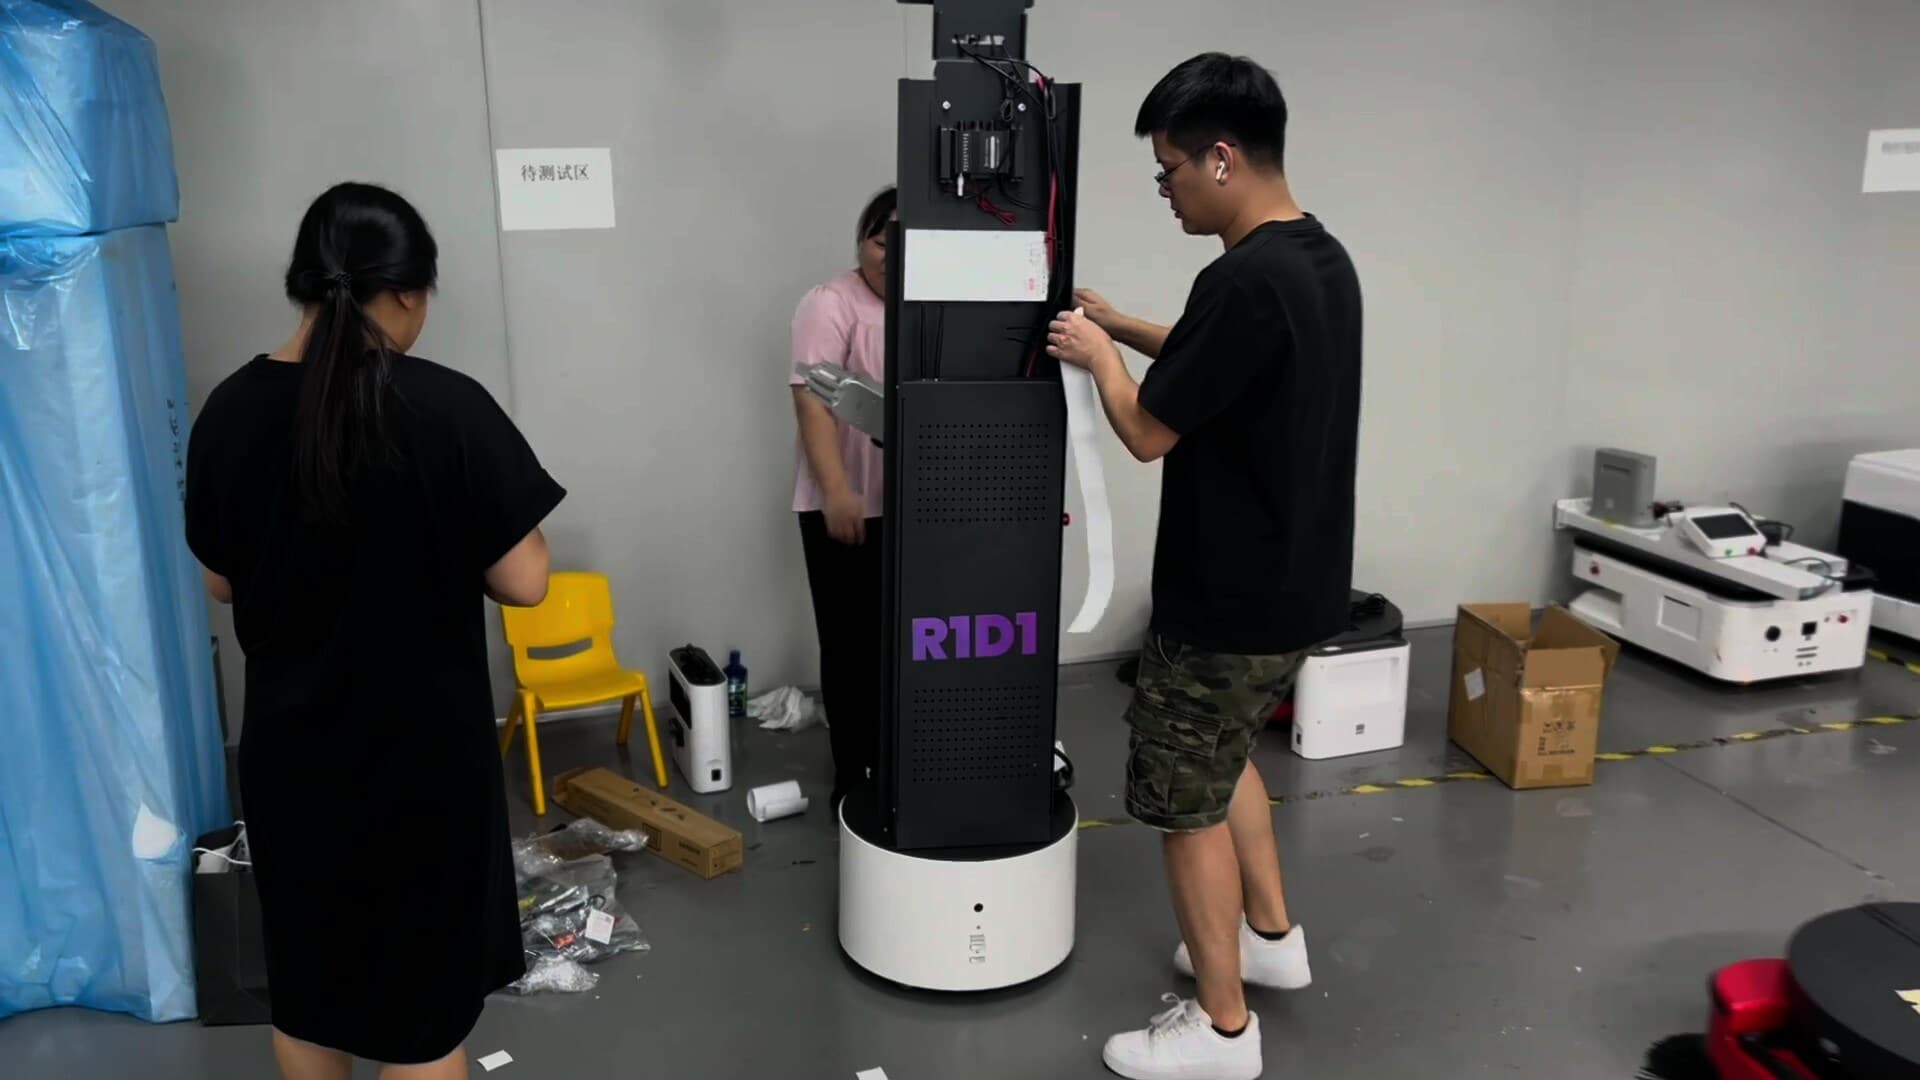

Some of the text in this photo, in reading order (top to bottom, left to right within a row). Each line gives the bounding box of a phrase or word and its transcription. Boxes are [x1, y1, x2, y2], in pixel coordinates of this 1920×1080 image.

[521, 164, 589, 182] 待测试区
[912, 611, 1037, 661] R1D1
